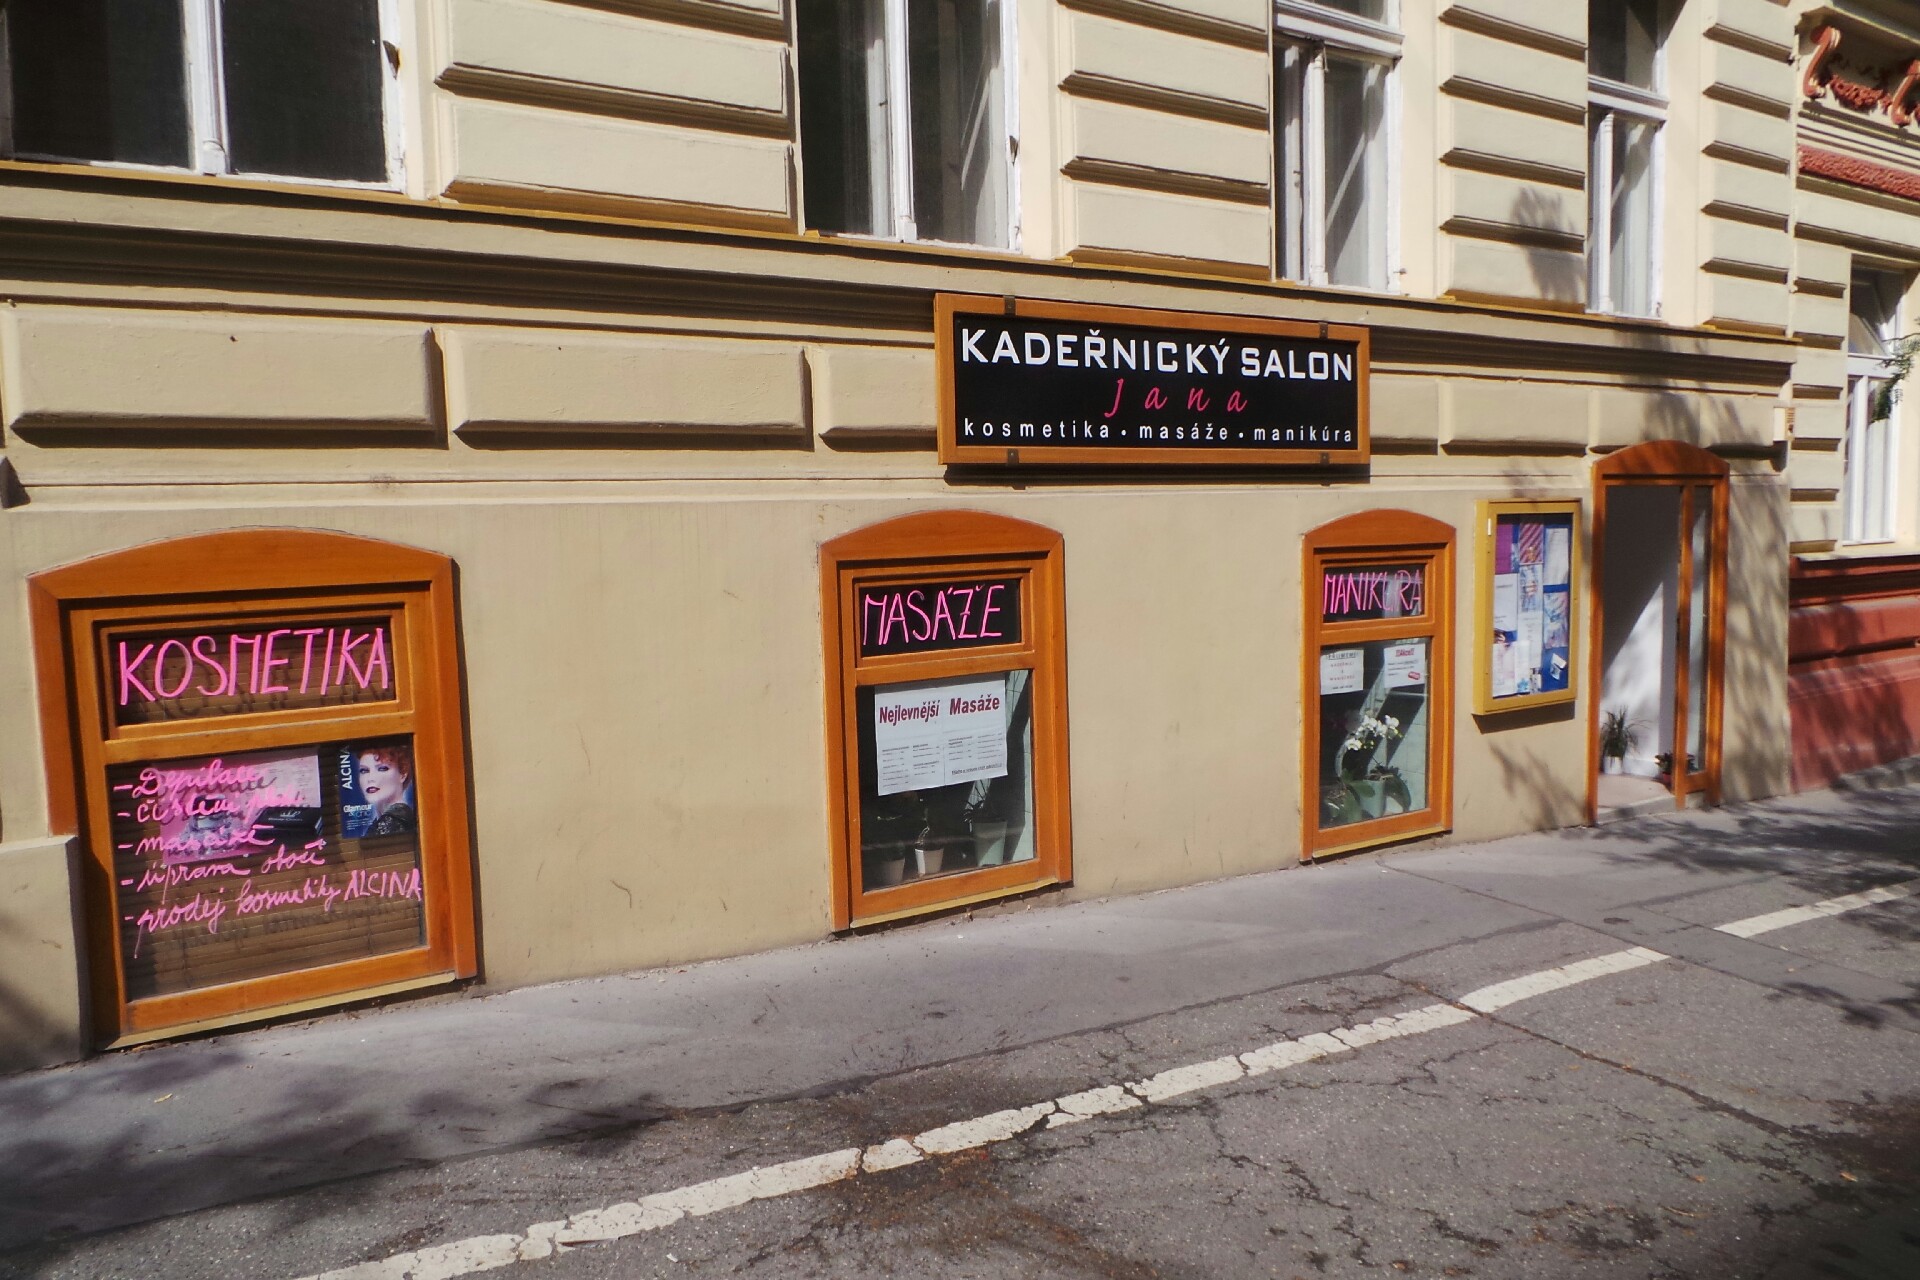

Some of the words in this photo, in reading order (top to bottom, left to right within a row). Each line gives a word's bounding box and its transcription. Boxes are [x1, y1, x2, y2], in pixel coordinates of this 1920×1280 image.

[961, 328, 1230, 375] KADEŘNICKÝ
[1240, 347, 1353, 381] SALON
[1104, 378, 1248, 418] Jana
[963, 418, 1110, 438] kosmetika
[1138, 423, 1229, 441] masáže
[1253, 425, 1352, 443] manikúra
[862, 584, 1005, 646] MASÁŽE
[119, 627, 389, 706] KOSMETIKA
[879, 700, 941, 727] Nejlevnější
[949, 694, 1001, 716] Masáže
[340, 745, 353, 790] ALCINA
[344, 868, 423, 902] ALCINA
